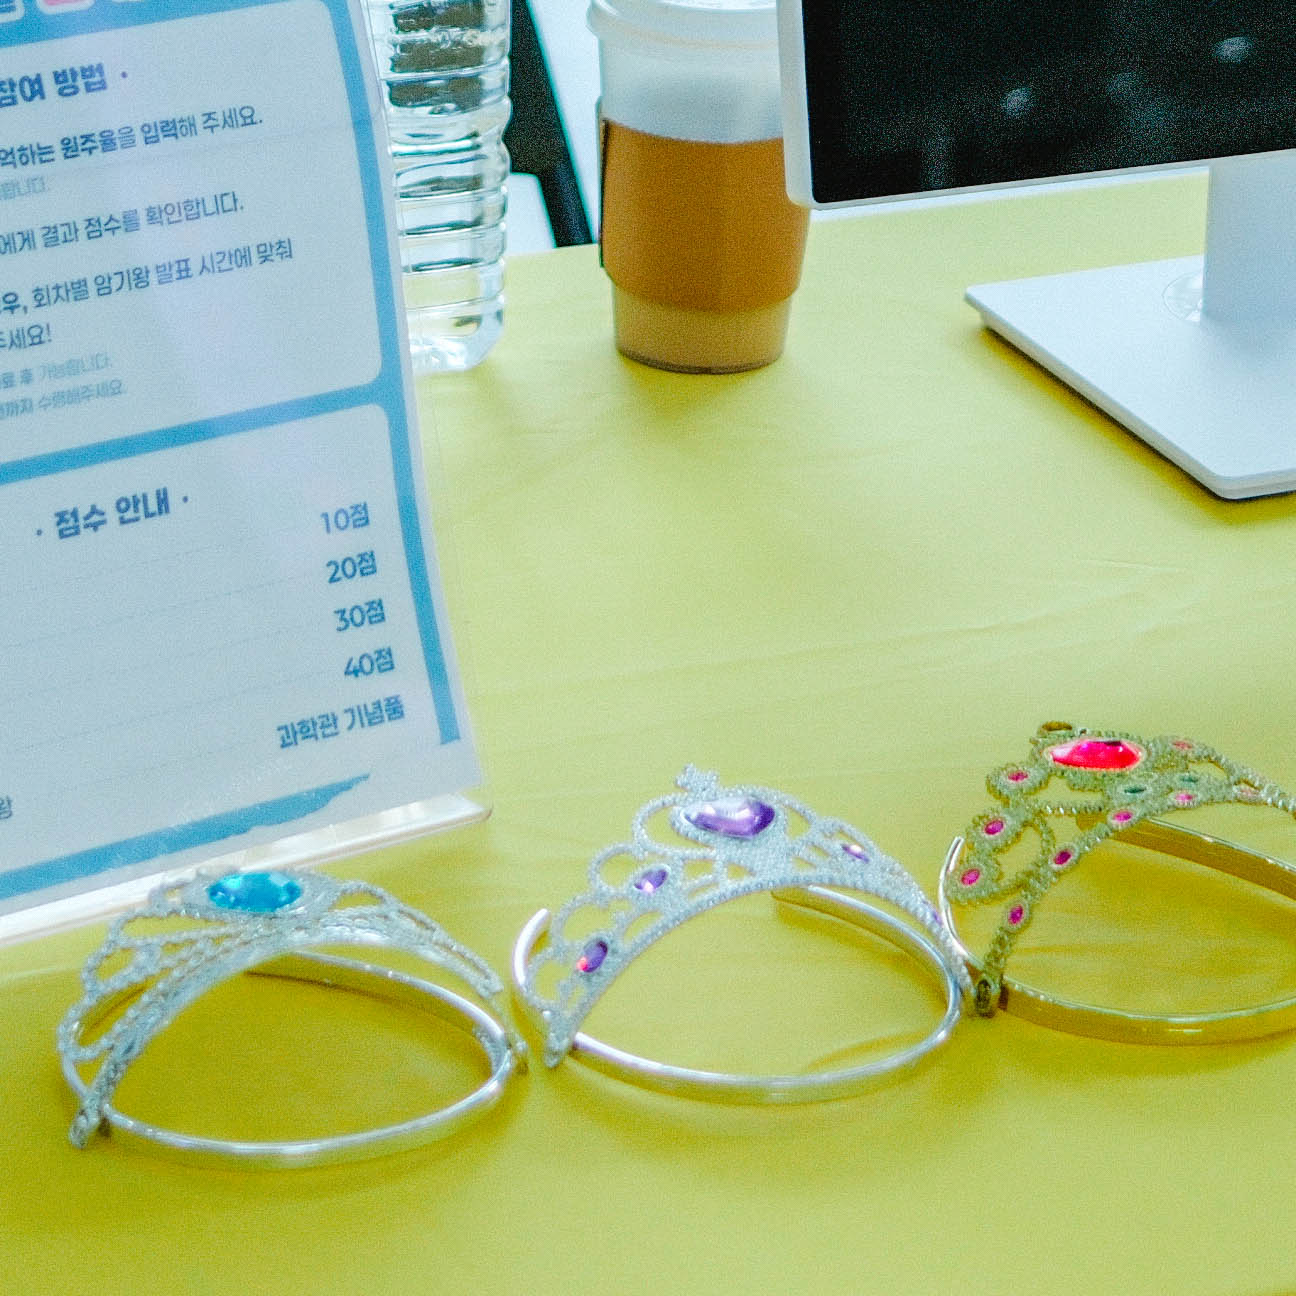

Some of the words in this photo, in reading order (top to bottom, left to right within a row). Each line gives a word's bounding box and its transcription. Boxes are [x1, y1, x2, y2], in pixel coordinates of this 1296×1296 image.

[52, 62, 108, 98] 방법
[60, 125, 137, 161] 원주율을
[140, 115, 199, 146] 입력해
[201, 105, 263, 135] 주세요.
[40, 220, 80, 249] 결과
[84, 208, 141, 242] 점수를
[146, 191, 245, 227] 확인합니다.
[31, 279, 90, 308] 회차별
[94, 265, 151, 297] 암기왕
[156, 257, 194, 285] 발표
[198, 247, 253, 276] 시간에
[256, 237, 294, 266] 맞춰
[54, 506, 107, 540] 점수
[115, 486, 171, 526] 안내
[320, 501, 371, 535] 10점
[325, 550, 378, 584] 20점
[333, 597, 386, 633] 30점
[343, 645, 396, 679] 40점
[275, 711, 340, 750] 과학관
[344, 693, 406, 732] 기념품
